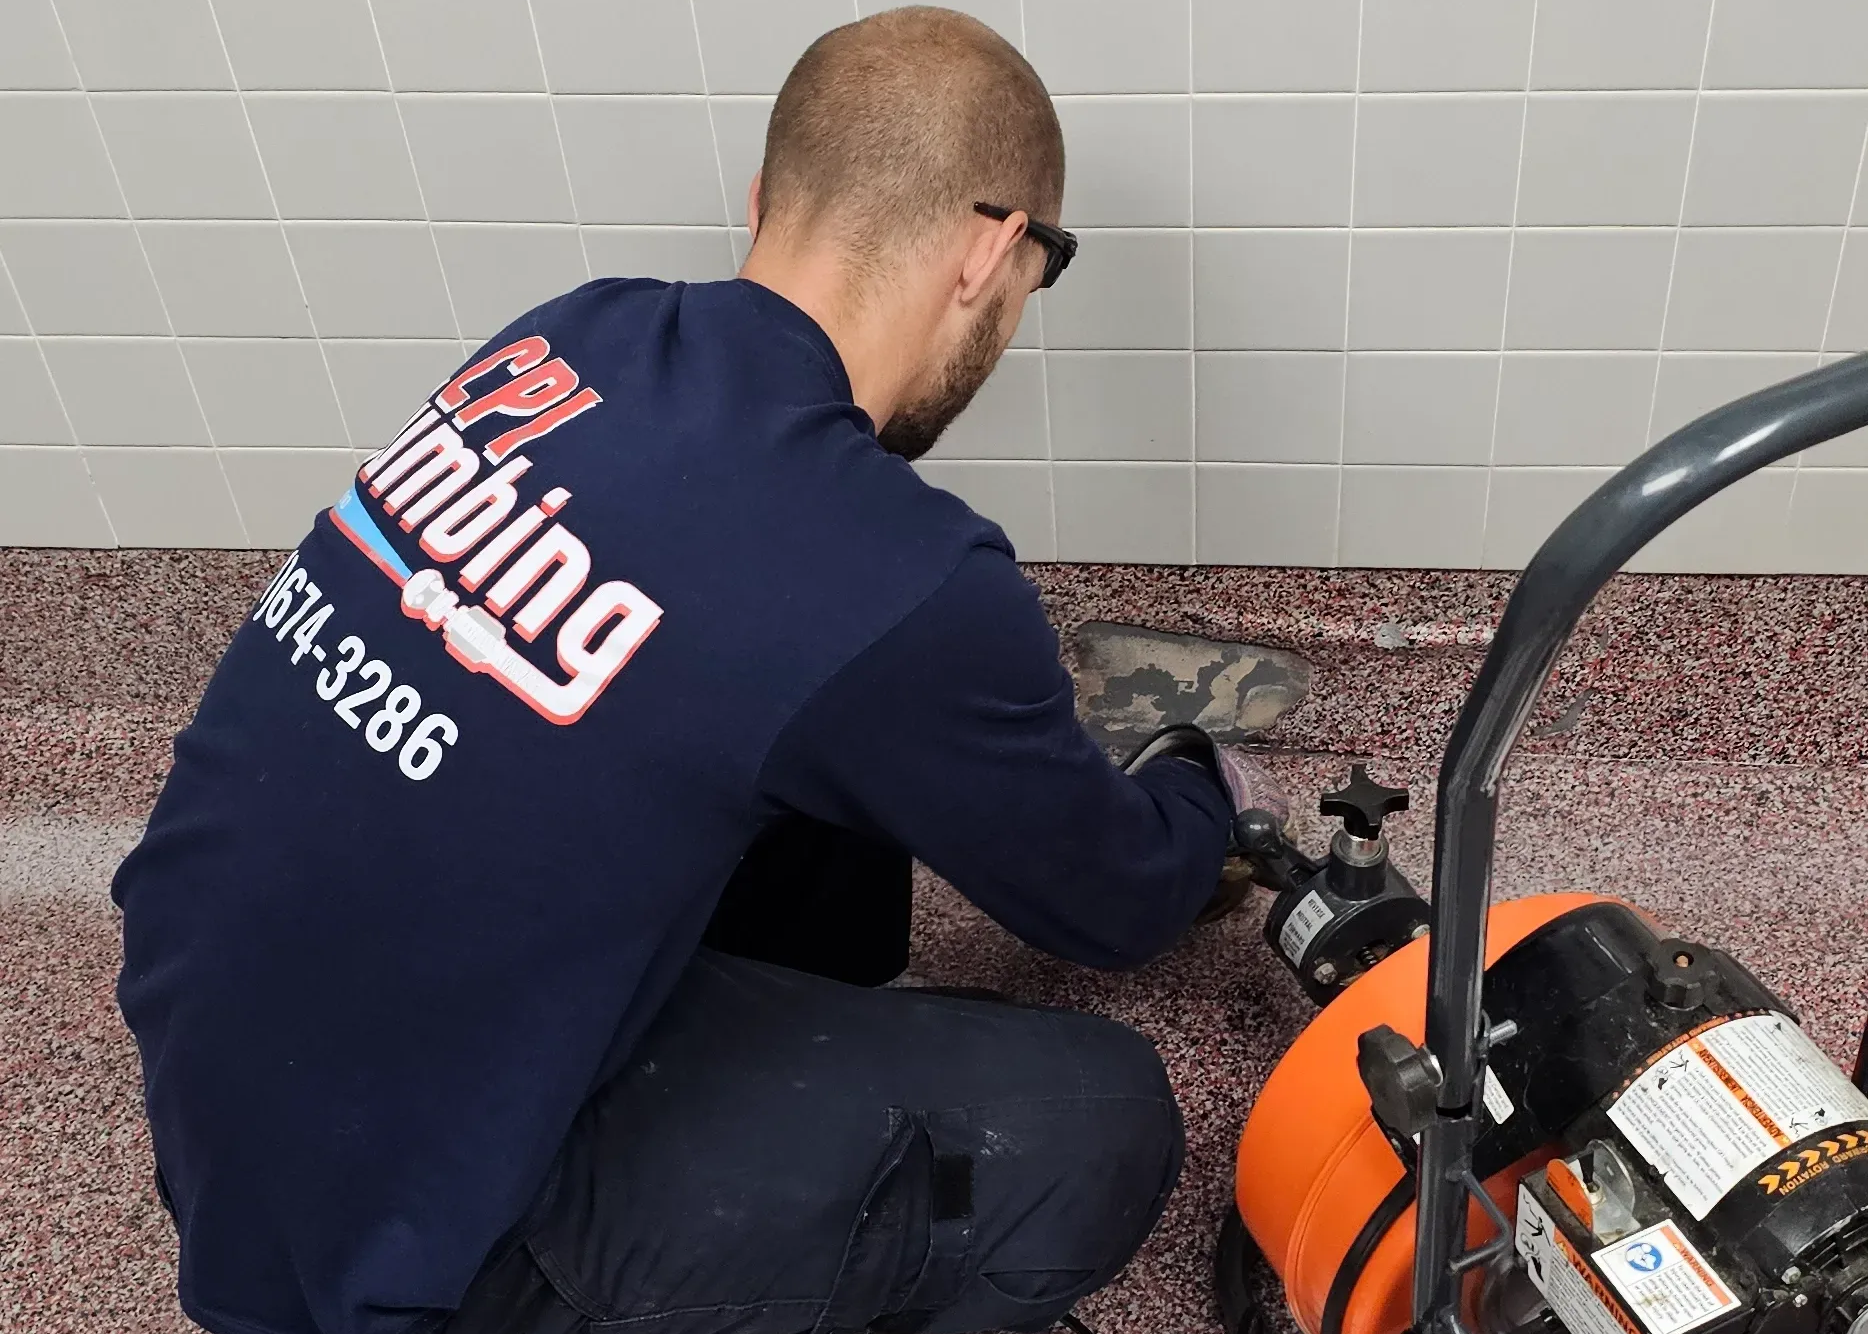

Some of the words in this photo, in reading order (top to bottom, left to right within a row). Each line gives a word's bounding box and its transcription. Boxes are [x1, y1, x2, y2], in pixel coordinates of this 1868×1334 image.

[432, 335, 604, 466] CPI
[1778, 1161, 1830, 1196] ROTATION
[1680, 1248, 1713, 1287] WARNING
